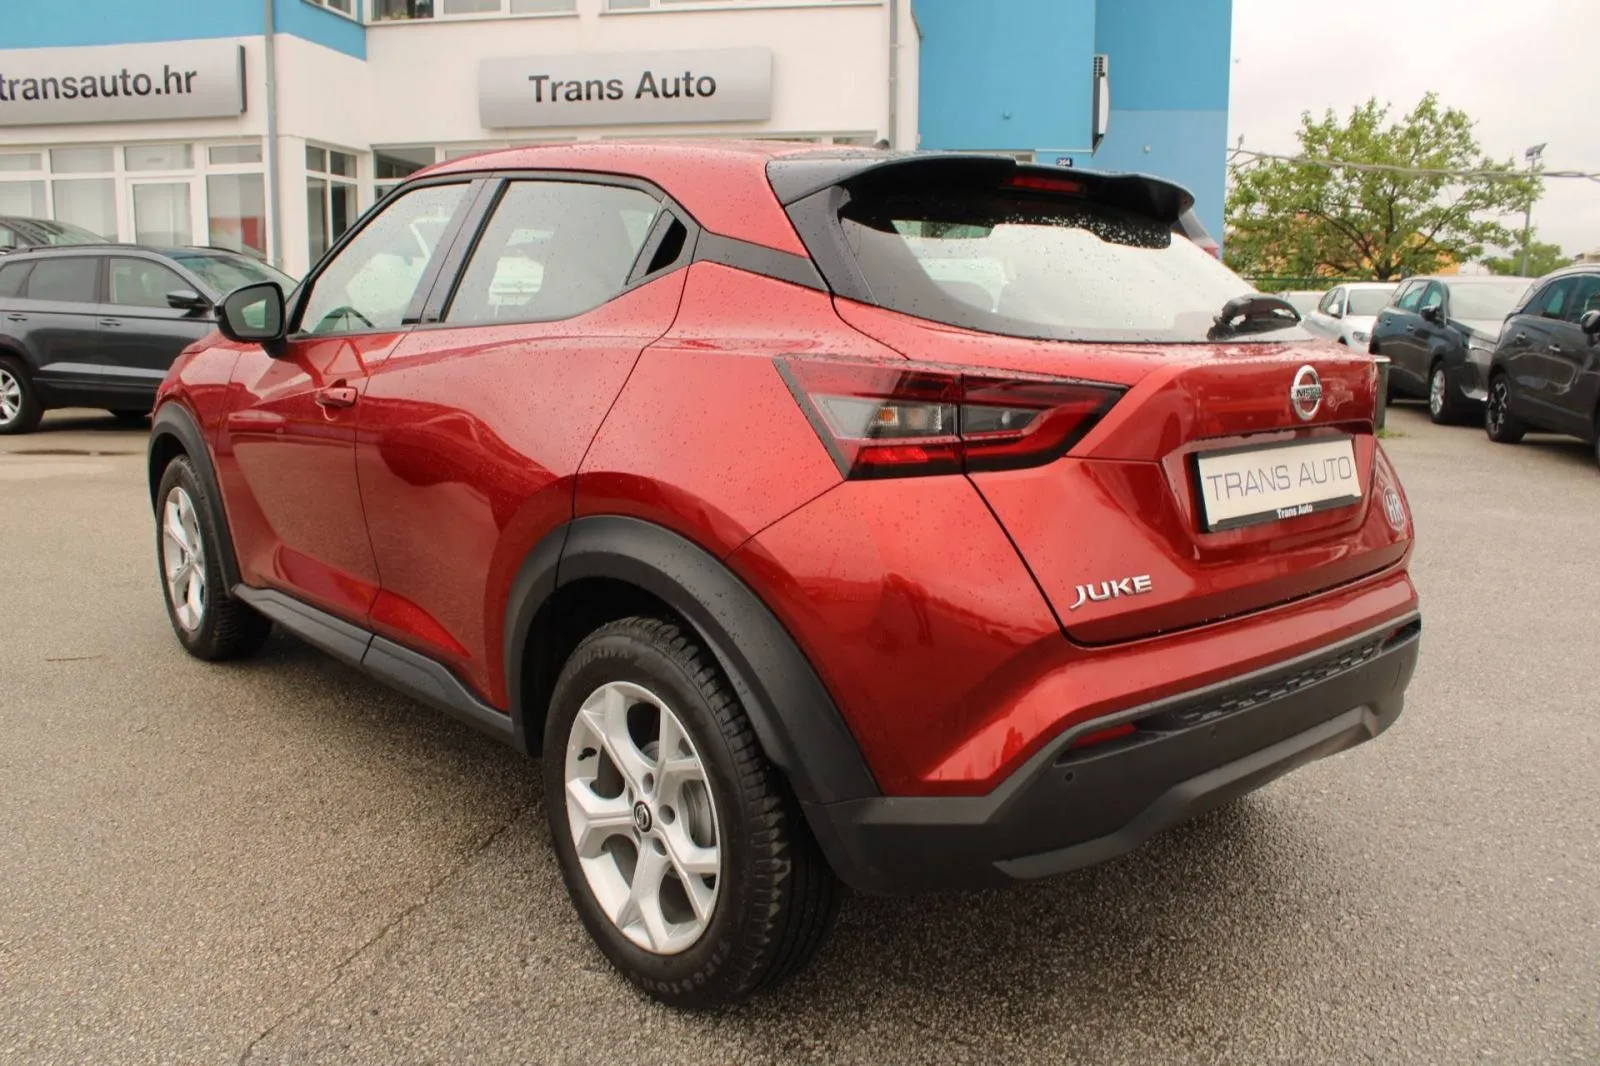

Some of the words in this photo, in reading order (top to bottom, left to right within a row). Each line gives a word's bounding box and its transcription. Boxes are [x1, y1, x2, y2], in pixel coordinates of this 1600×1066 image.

[0, 65, 197, 101] transauto.hr
[528, 74, 624, 103] Trans
[634, 70, 717, 99] Auto
[1206, 464, 1291, 502] TRANS
[1299, 456, 1352, 487] AUTO
[1276, 507, 1297, 519] Trans
[1069, 574, 1153, 611] JUKE
